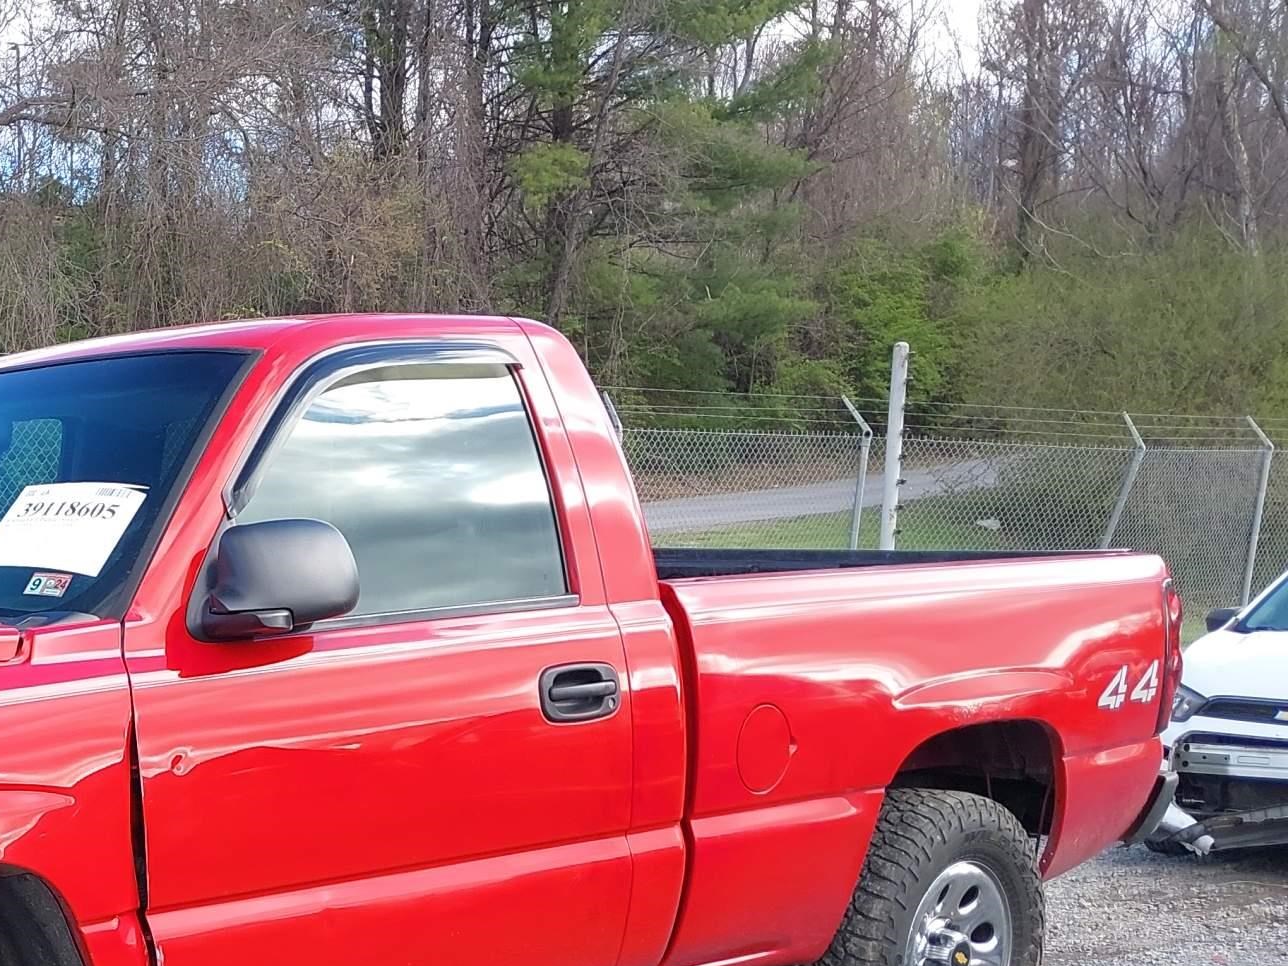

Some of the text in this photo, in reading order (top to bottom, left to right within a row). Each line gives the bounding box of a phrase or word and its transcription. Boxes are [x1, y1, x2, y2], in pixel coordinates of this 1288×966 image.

[16, 501, 120, 520] 39118605
[29, 578, 67, 591] 9 24
